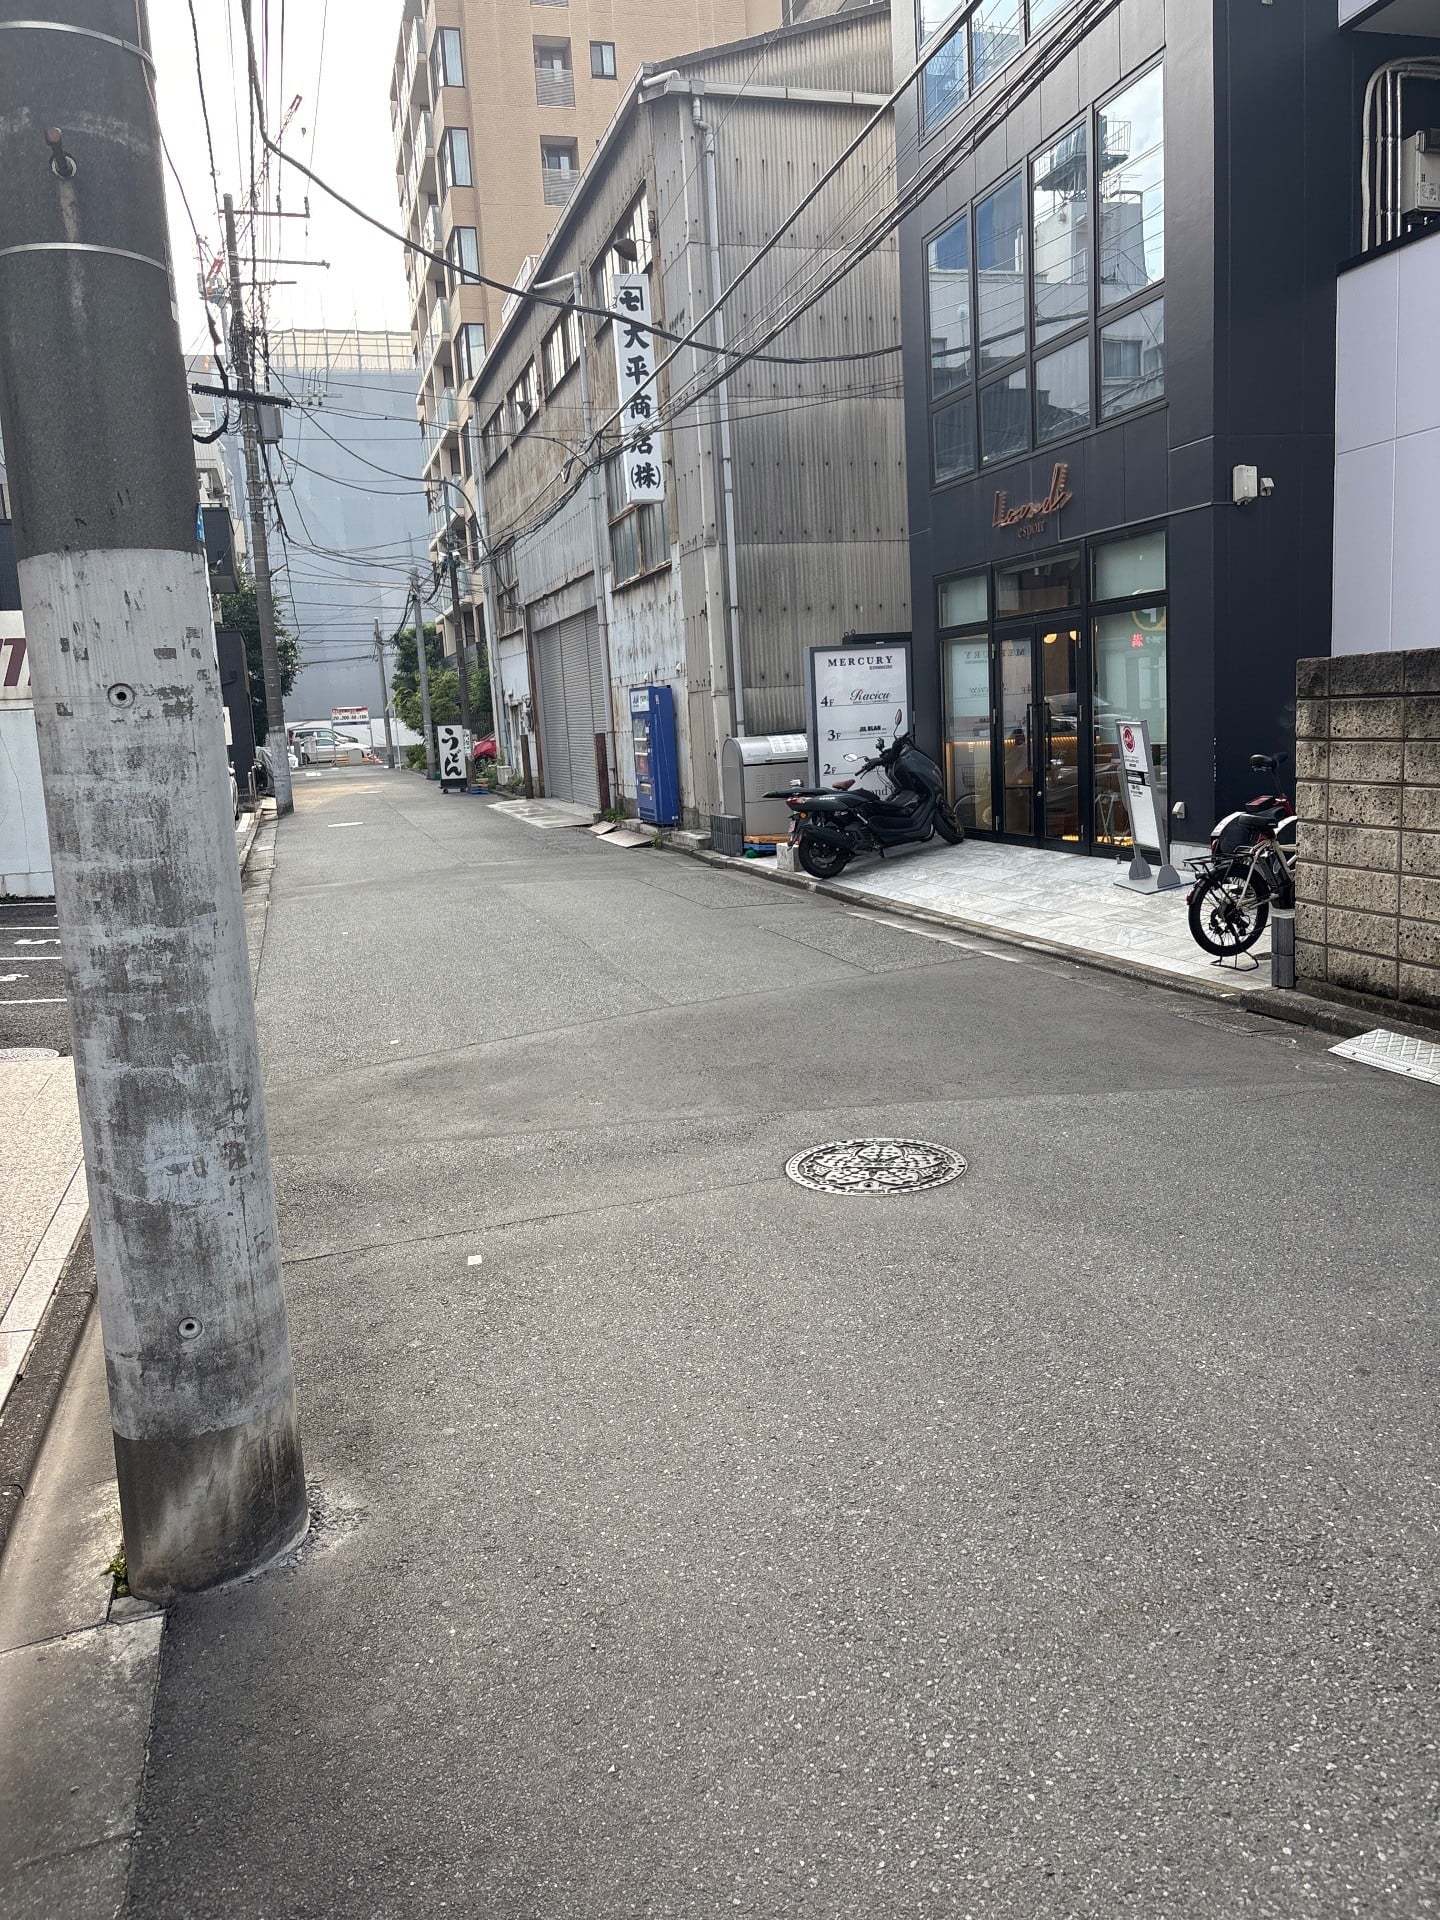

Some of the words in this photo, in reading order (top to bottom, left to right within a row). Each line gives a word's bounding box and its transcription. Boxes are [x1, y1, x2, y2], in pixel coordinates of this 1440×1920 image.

[827, 655, 893, 668] MERCURY
[820, 696, 835, 707] 4F
[827, 729, 842, 741] 3F
[441, 727, 463, 778] うどん
[823, 763, 837, 775] 2F
